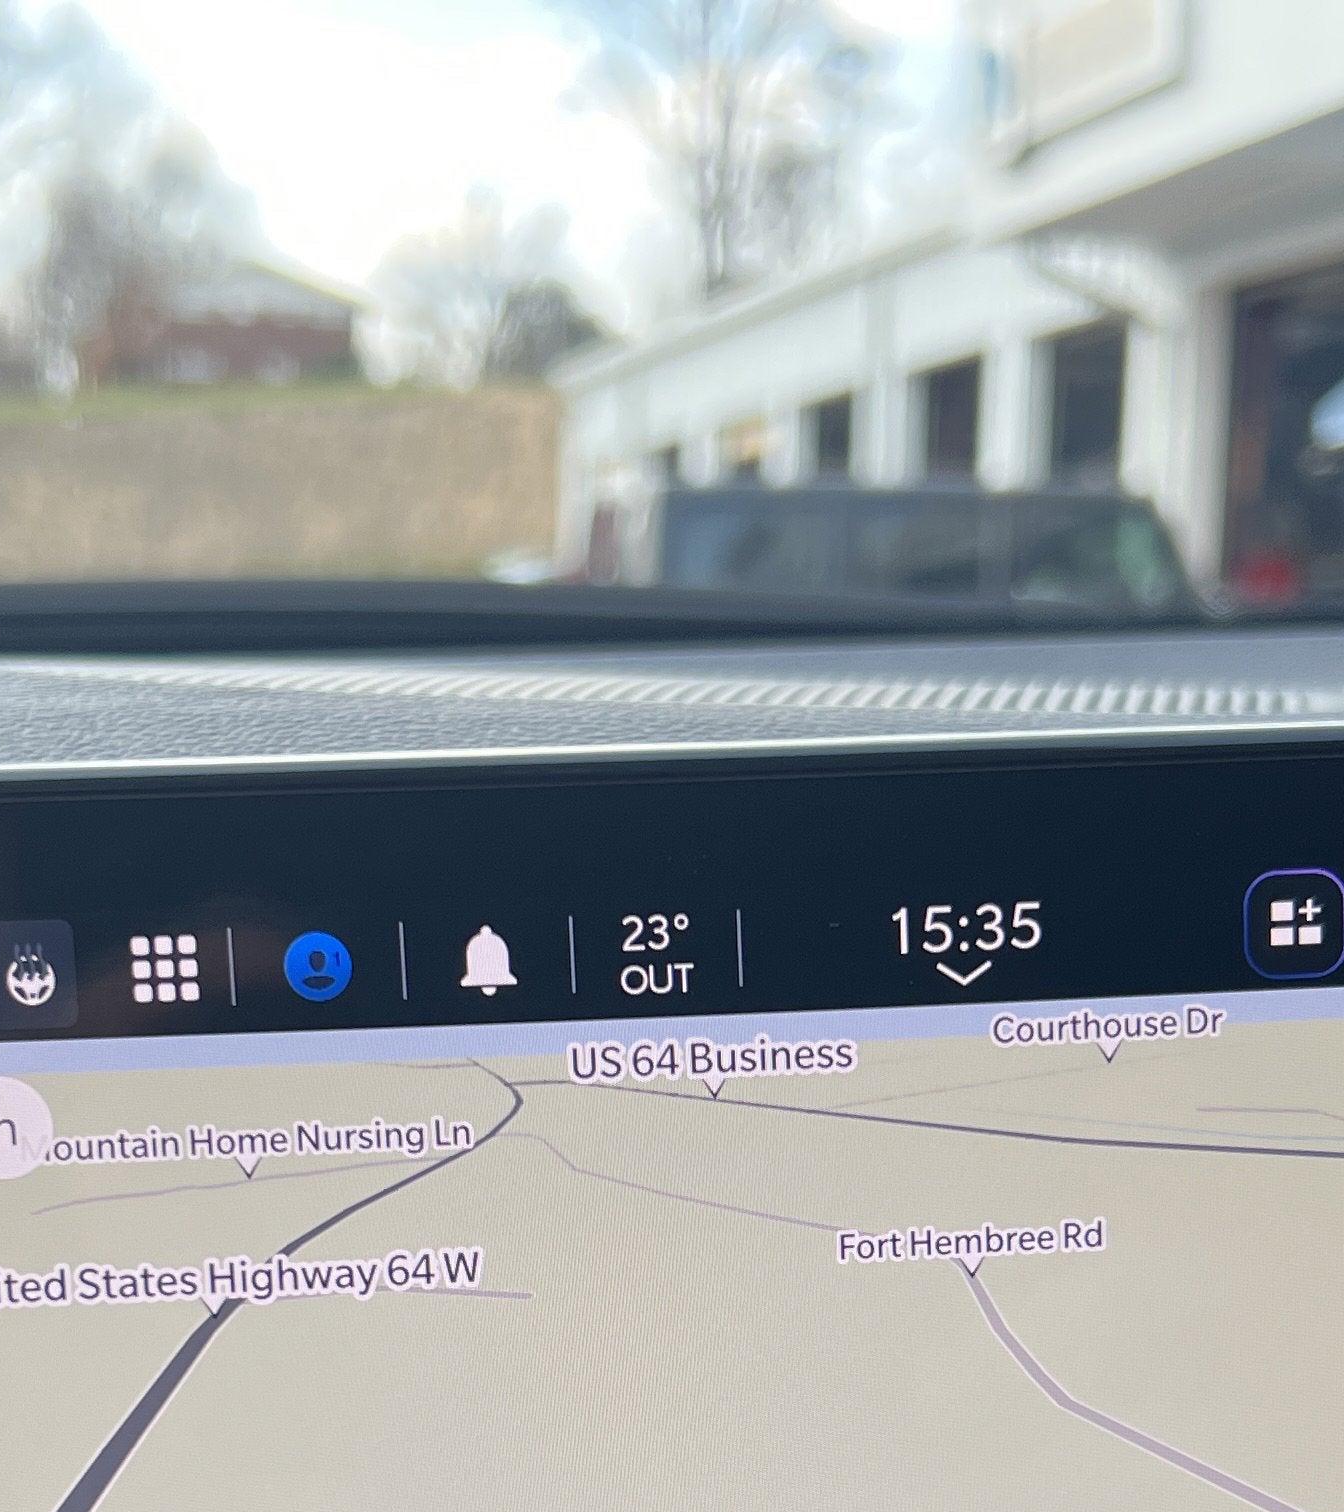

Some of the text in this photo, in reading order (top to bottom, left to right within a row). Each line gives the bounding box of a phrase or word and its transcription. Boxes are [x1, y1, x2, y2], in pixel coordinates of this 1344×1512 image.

[621, 913, 689, 953] 23°
[891, 901, 1042, 954] 15:35
[620, 962, 694, 996] OUT
[993, 1007, 1223, 1043] Courthouse Dr
[571, 1038, 853, 1079] US 64 Business
[44, 1118, 473, 1162] ountain Home Nursing Ln
[839, 1220, 1103, 1261] Fort Hembree Rd
[79, 1263, 197, 1302] States
[209, 1257, 377, 1298] Highway
[388, 1253, 435, 1288] 64
[444, 1251, 481, 1284] W
